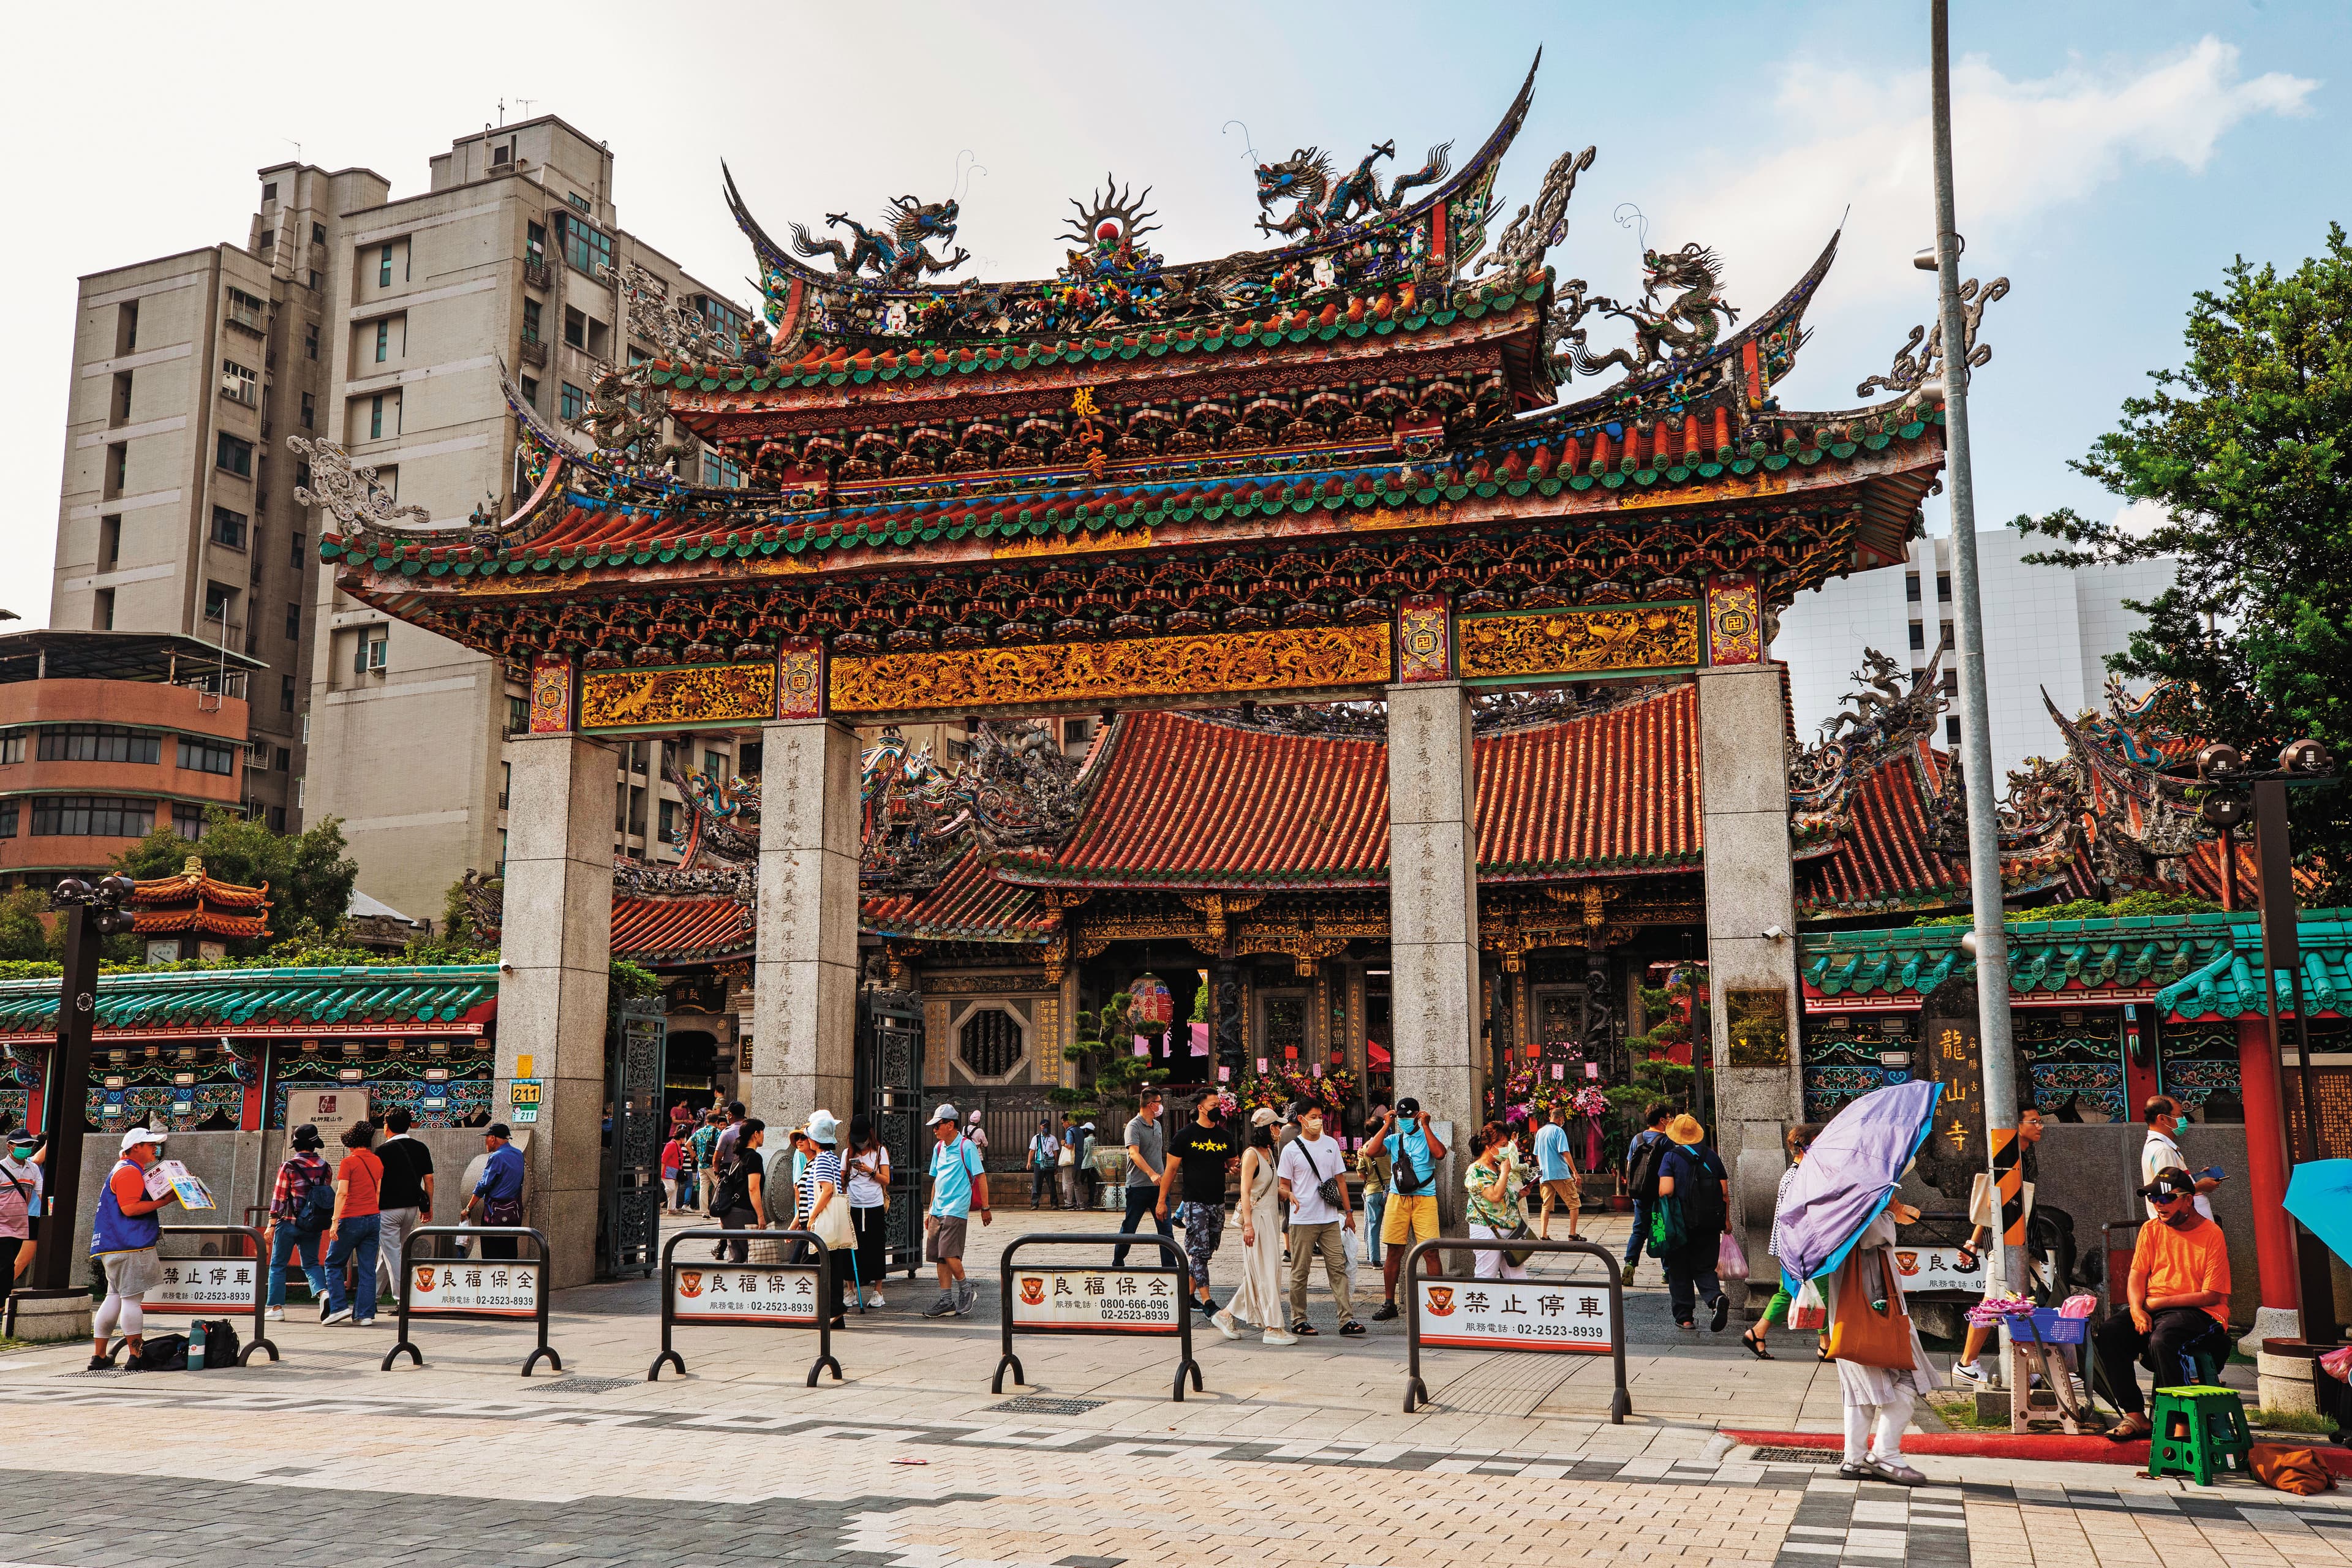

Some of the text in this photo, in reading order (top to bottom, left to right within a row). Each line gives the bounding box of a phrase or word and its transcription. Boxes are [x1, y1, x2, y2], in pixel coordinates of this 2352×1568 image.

[1071, 386, 1107, 480] 龍山寺
[1966, 1036, 1980, 1114] 名勝古蹟
[514, 1088, 537, 1101] 211
[1939, 1028, 1969, 1152] 龍山寺
[521, 1112, 534, 1120] 211
[163, 1267, 252, 1286] 禁止停車
[442, 1269, 533, 1289] 良福保全
[710, 1273, 813, 1295] 良福保全
[1054, 1276, 1169, 1297] 良福保全
[194, 1292, 250, 1300] 02-2523-8939
[476, 1295, 533, 1305] 02-2523-8939
[1100, 1298, 1169, 1310] 0800-666-096
[751, 1301, 813, 1313] 02-2523-8939
[1464, 1291, 1604, 1319] 禁止停車
[1101, 1310, 1169, 1321] 02-2523-8939
[1517, 1323, 1603, 1338] 02-2523-8939
